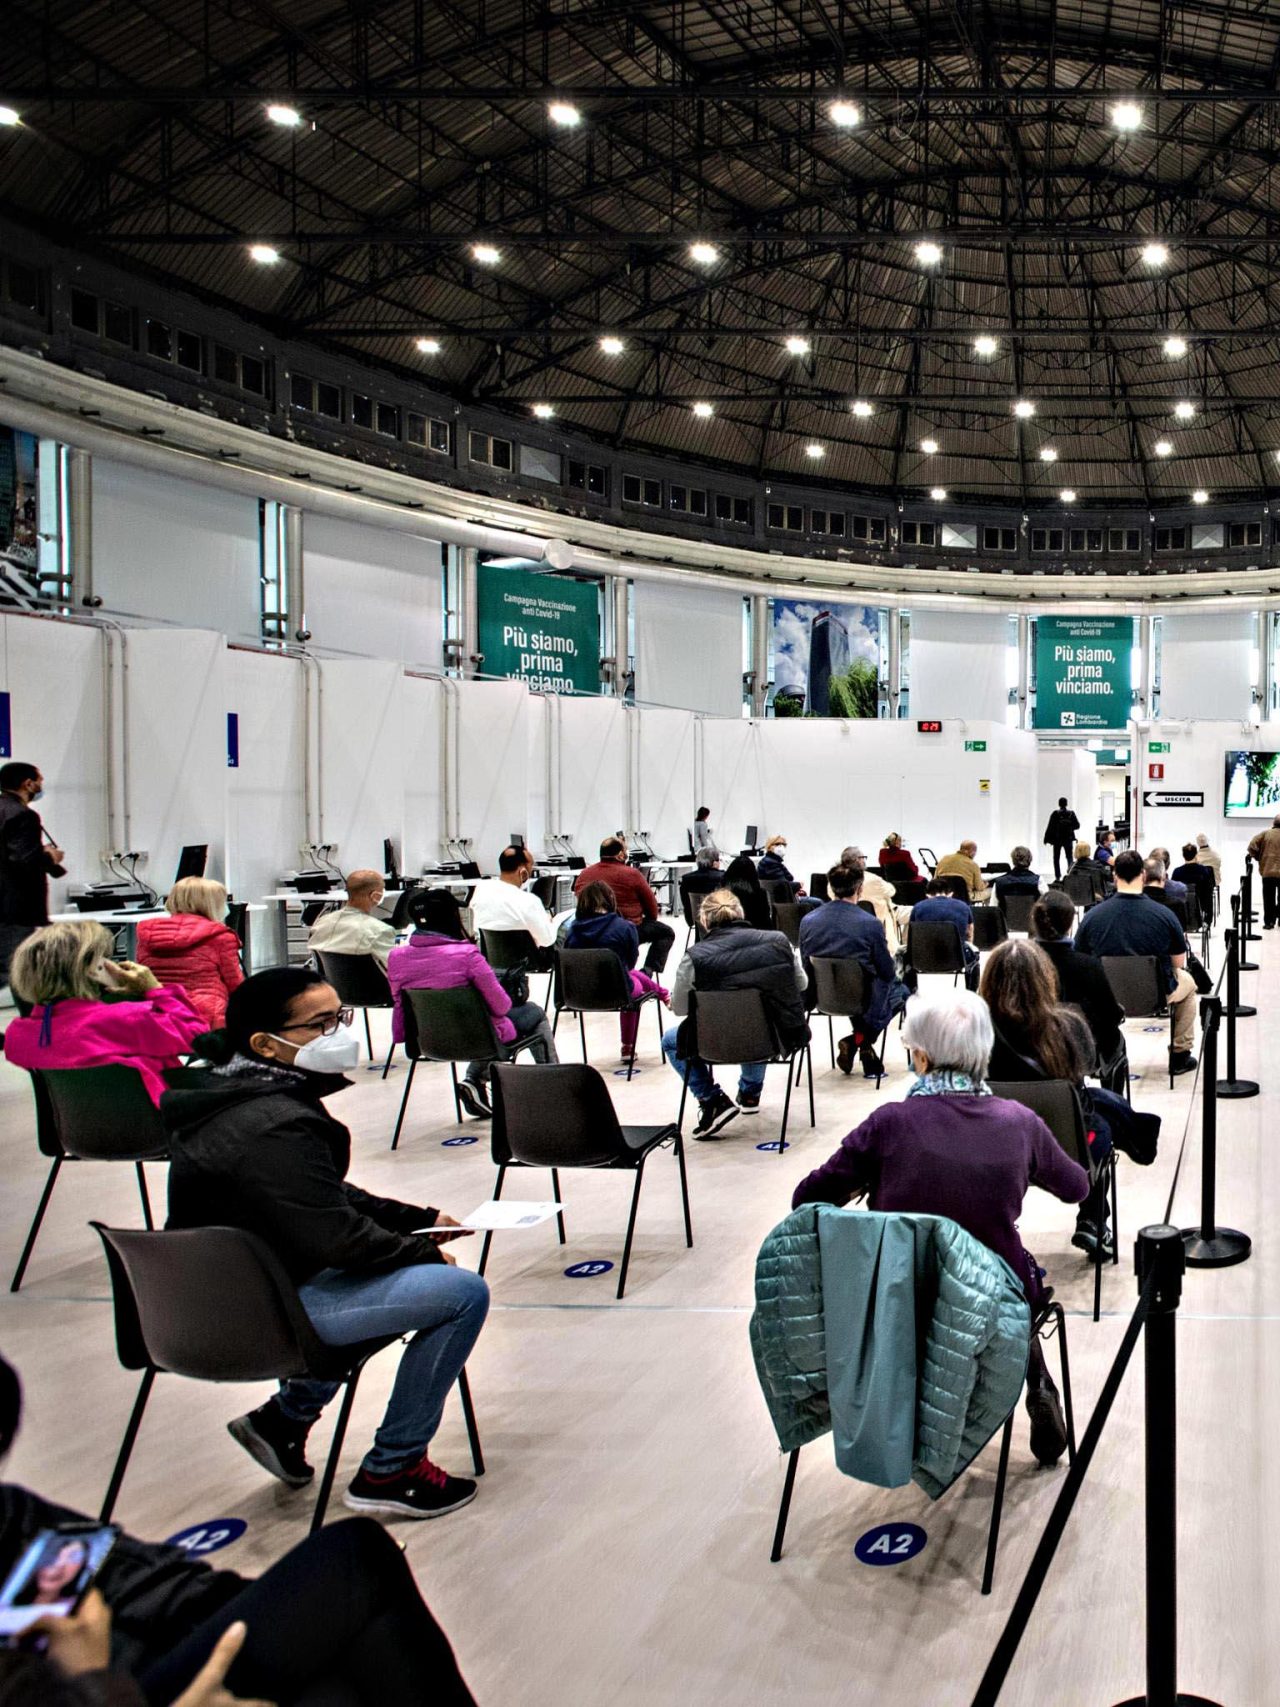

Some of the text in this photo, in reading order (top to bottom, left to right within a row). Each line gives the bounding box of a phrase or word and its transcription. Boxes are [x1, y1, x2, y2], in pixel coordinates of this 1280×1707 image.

[503, 593, 577, 613] Campagna Vaccinazione
[522, 607, 560, 620] anti Covid-19
[503, 625, 578, 657] Più siamo,
[521, 650, 563, 674] prima
[1054, 645, 1116, 664] Più siamo,
[1068, 662, 1103, 681] prima
[1055, 677, 1114, 695] vinciamo.
[571, 1264, 605, 1274] A2
[177, 1529, 230, 1551] A2
[866, 1533, 914, 1554] A2
